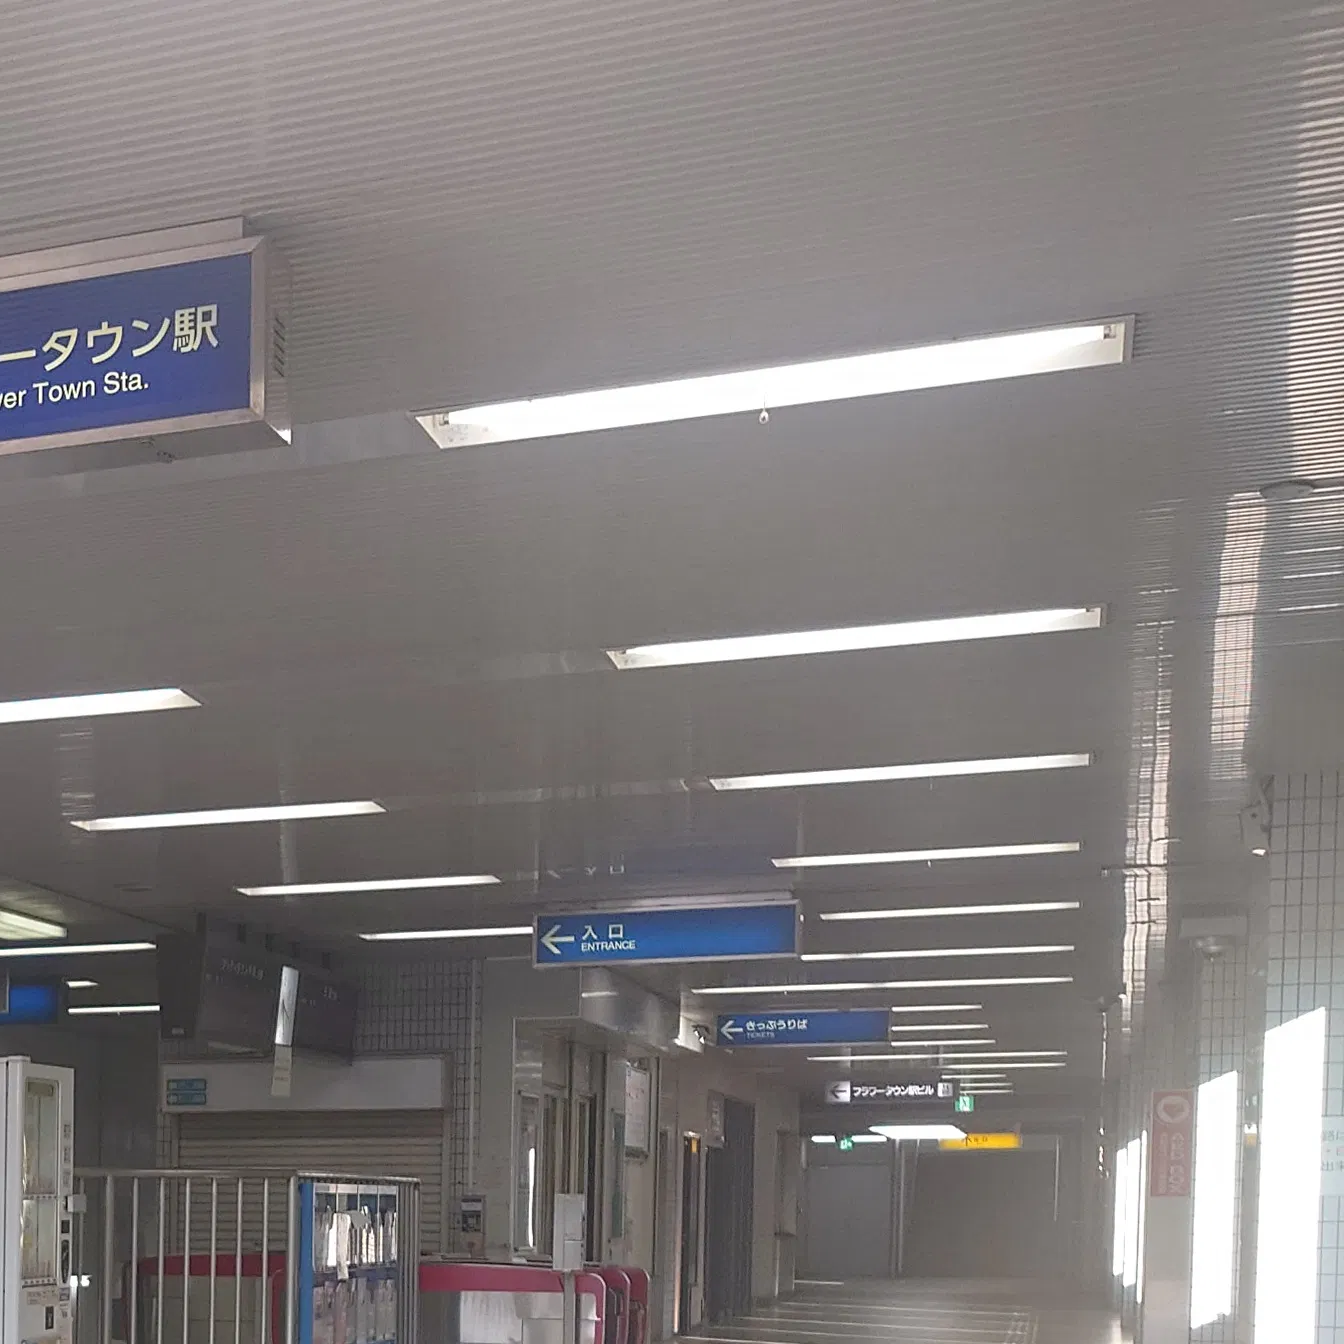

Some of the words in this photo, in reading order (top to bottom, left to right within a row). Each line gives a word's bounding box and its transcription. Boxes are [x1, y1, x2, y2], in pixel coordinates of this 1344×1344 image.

[32, 379, 96, 407] Town
[103, 371, 150, 397] Sta.
[581, 924, 624, 941] 入口
[580, 939, 636, 952] ENTRANCE
[745, 1018, 809, 1032] きっぷうりば
[852, 1084, 935, 1097] フラワータウン駅ビル
